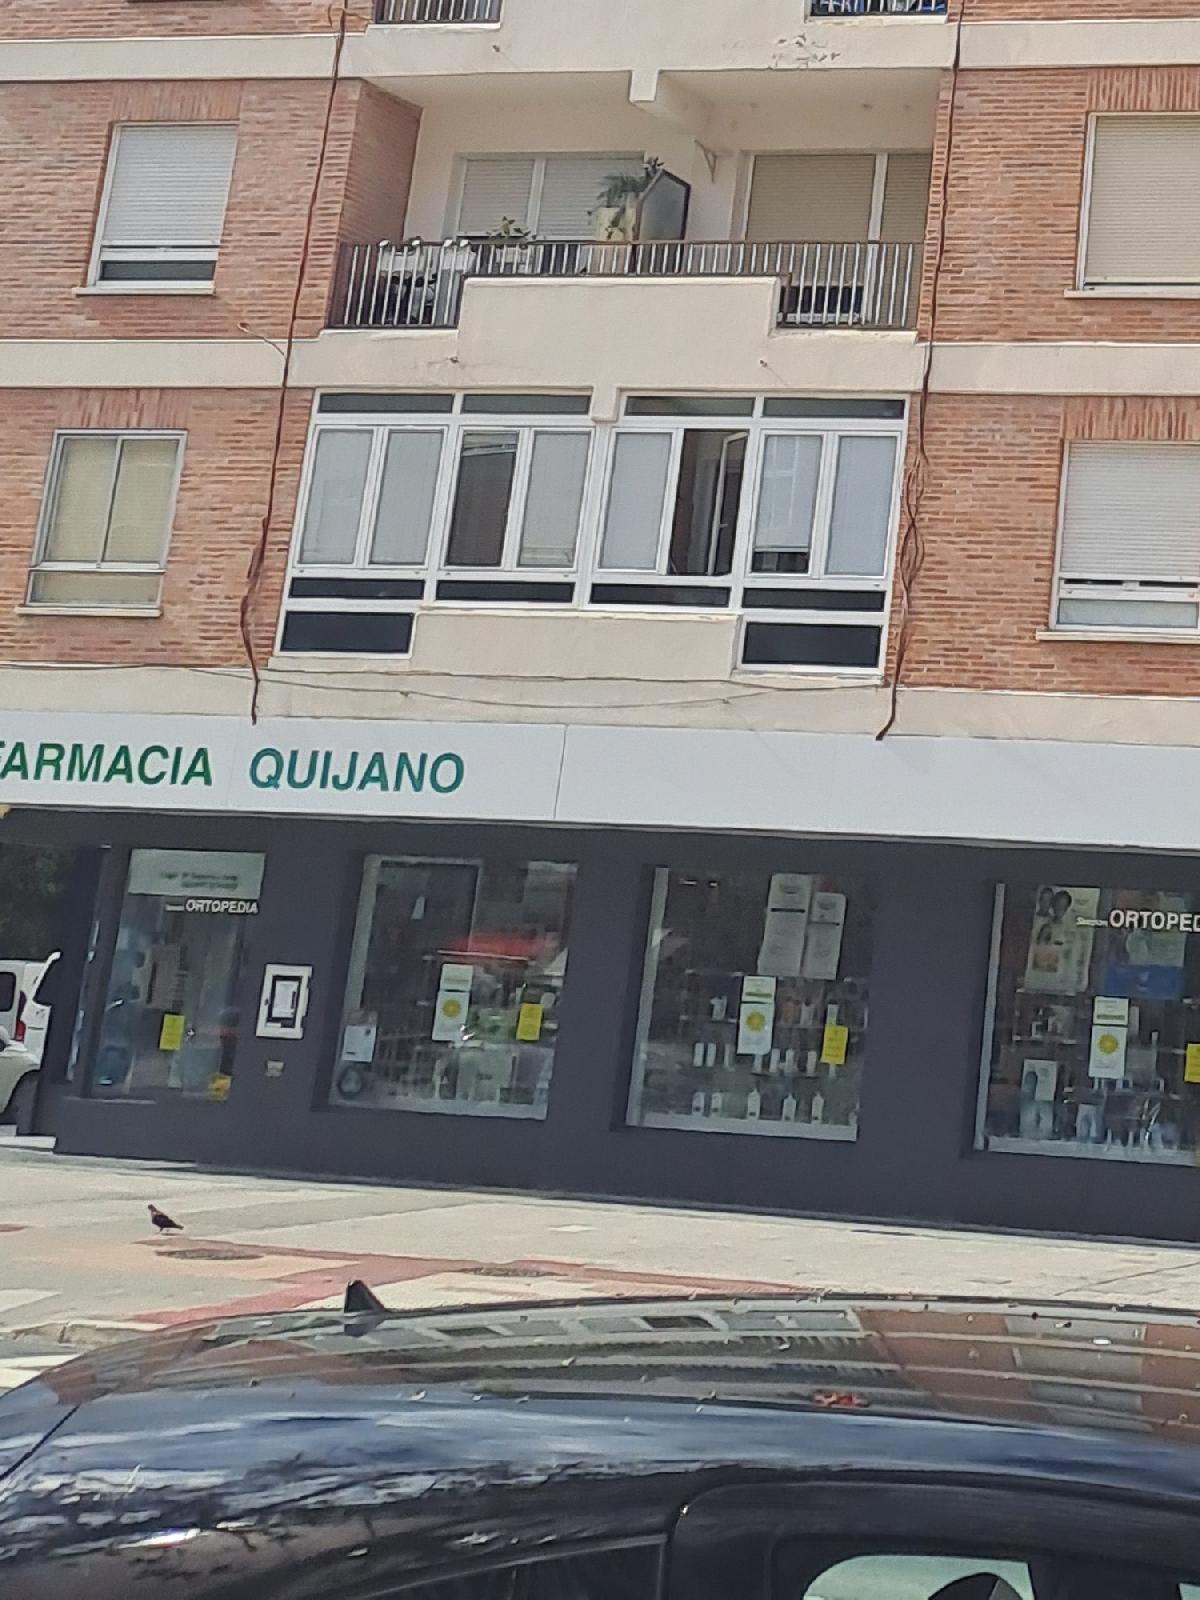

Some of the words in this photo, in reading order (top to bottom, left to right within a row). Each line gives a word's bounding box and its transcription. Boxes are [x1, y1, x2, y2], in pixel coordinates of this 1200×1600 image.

[0, 741, 213, 786] ARMACIA
[249, 747, 465, 794] QUIJANO
[185, 899, 259, 914] ORTOPEDIA
